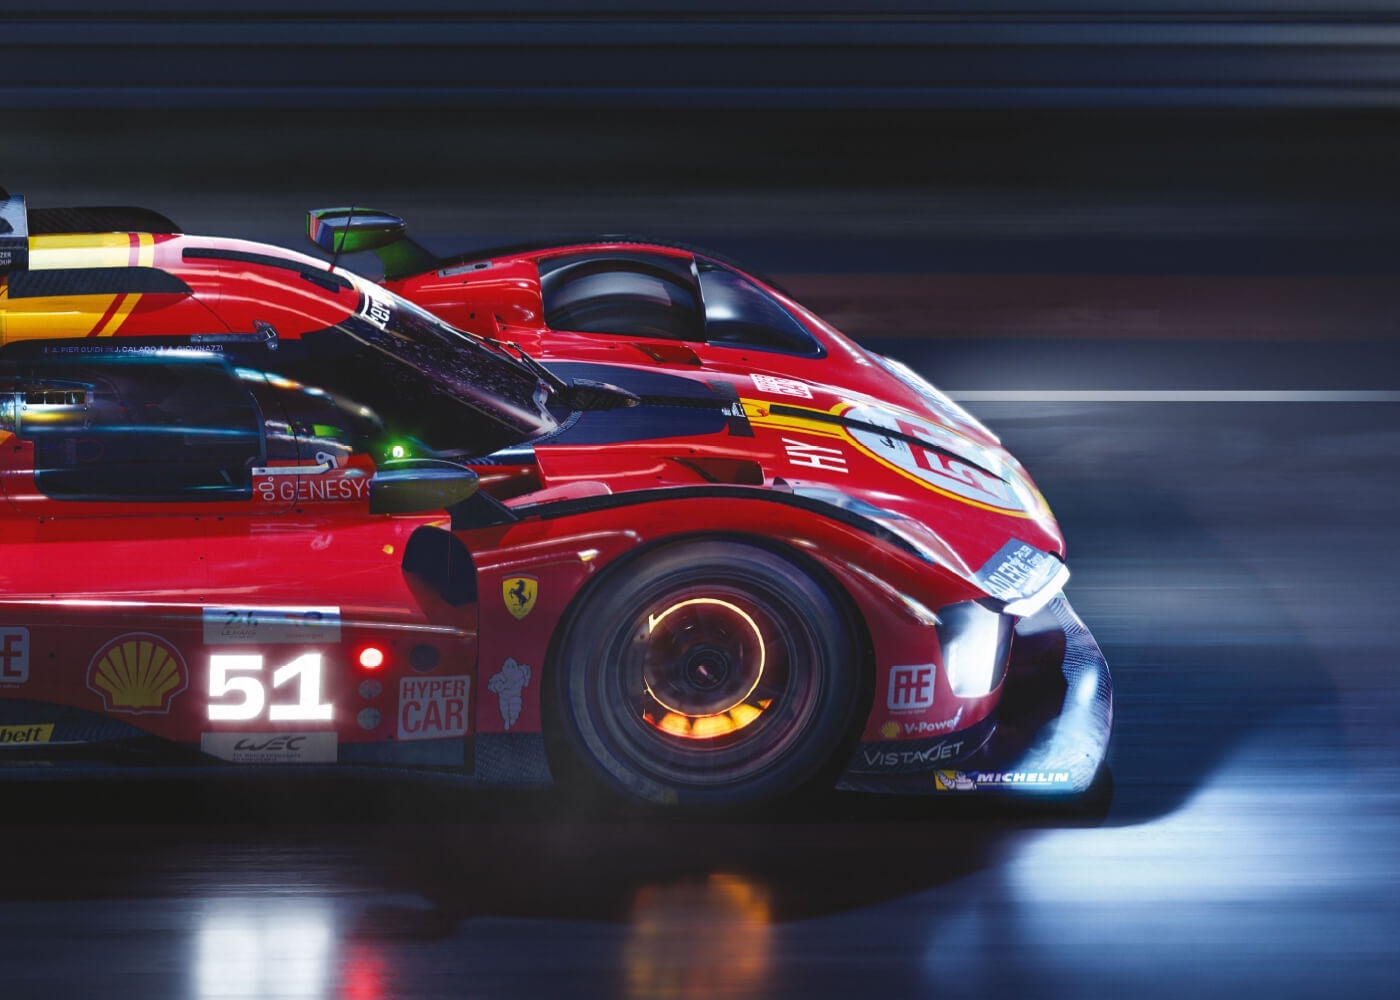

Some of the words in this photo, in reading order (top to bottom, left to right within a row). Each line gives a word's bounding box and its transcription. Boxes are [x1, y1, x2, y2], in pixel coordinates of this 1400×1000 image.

[781, 437, 848, 473] HY
[208, 653, 333, 721] 51
[403, 679, 466, 699] HYPER
[402, 699, 464, 733] CAR
[234, 736, 307, 751] WEC
[976, 772, 1069, 782] MICHELIN
